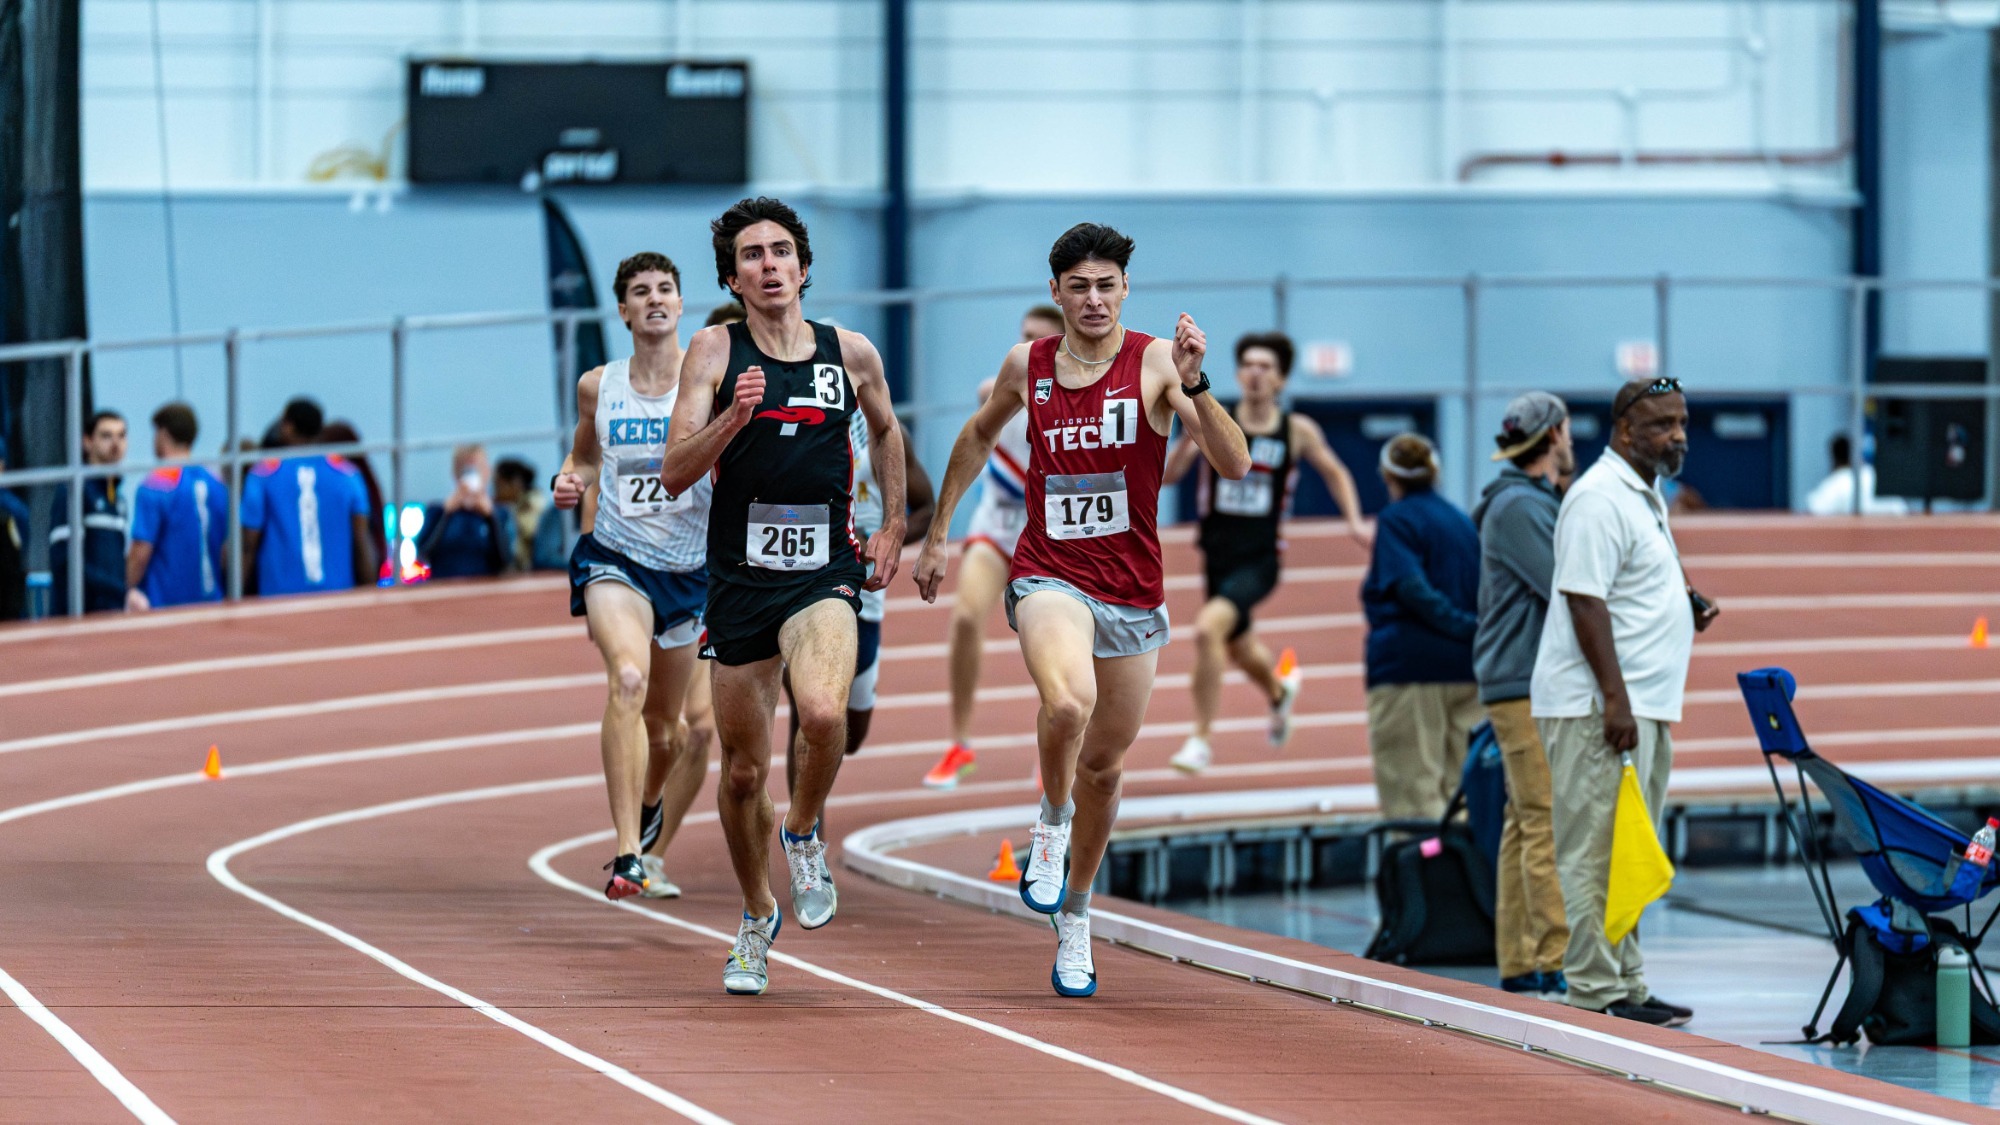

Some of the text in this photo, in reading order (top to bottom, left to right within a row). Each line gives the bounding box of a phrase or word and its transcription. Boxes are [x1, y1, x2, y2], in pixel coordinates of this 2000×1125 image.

[819, 366, 841, 405] 3
[1108, 401, 1125, 442] 1
[629, 477, 679, 504] 22
[1061, 495, 1114, 525] 179
[761, 526, 816, 557] 265
